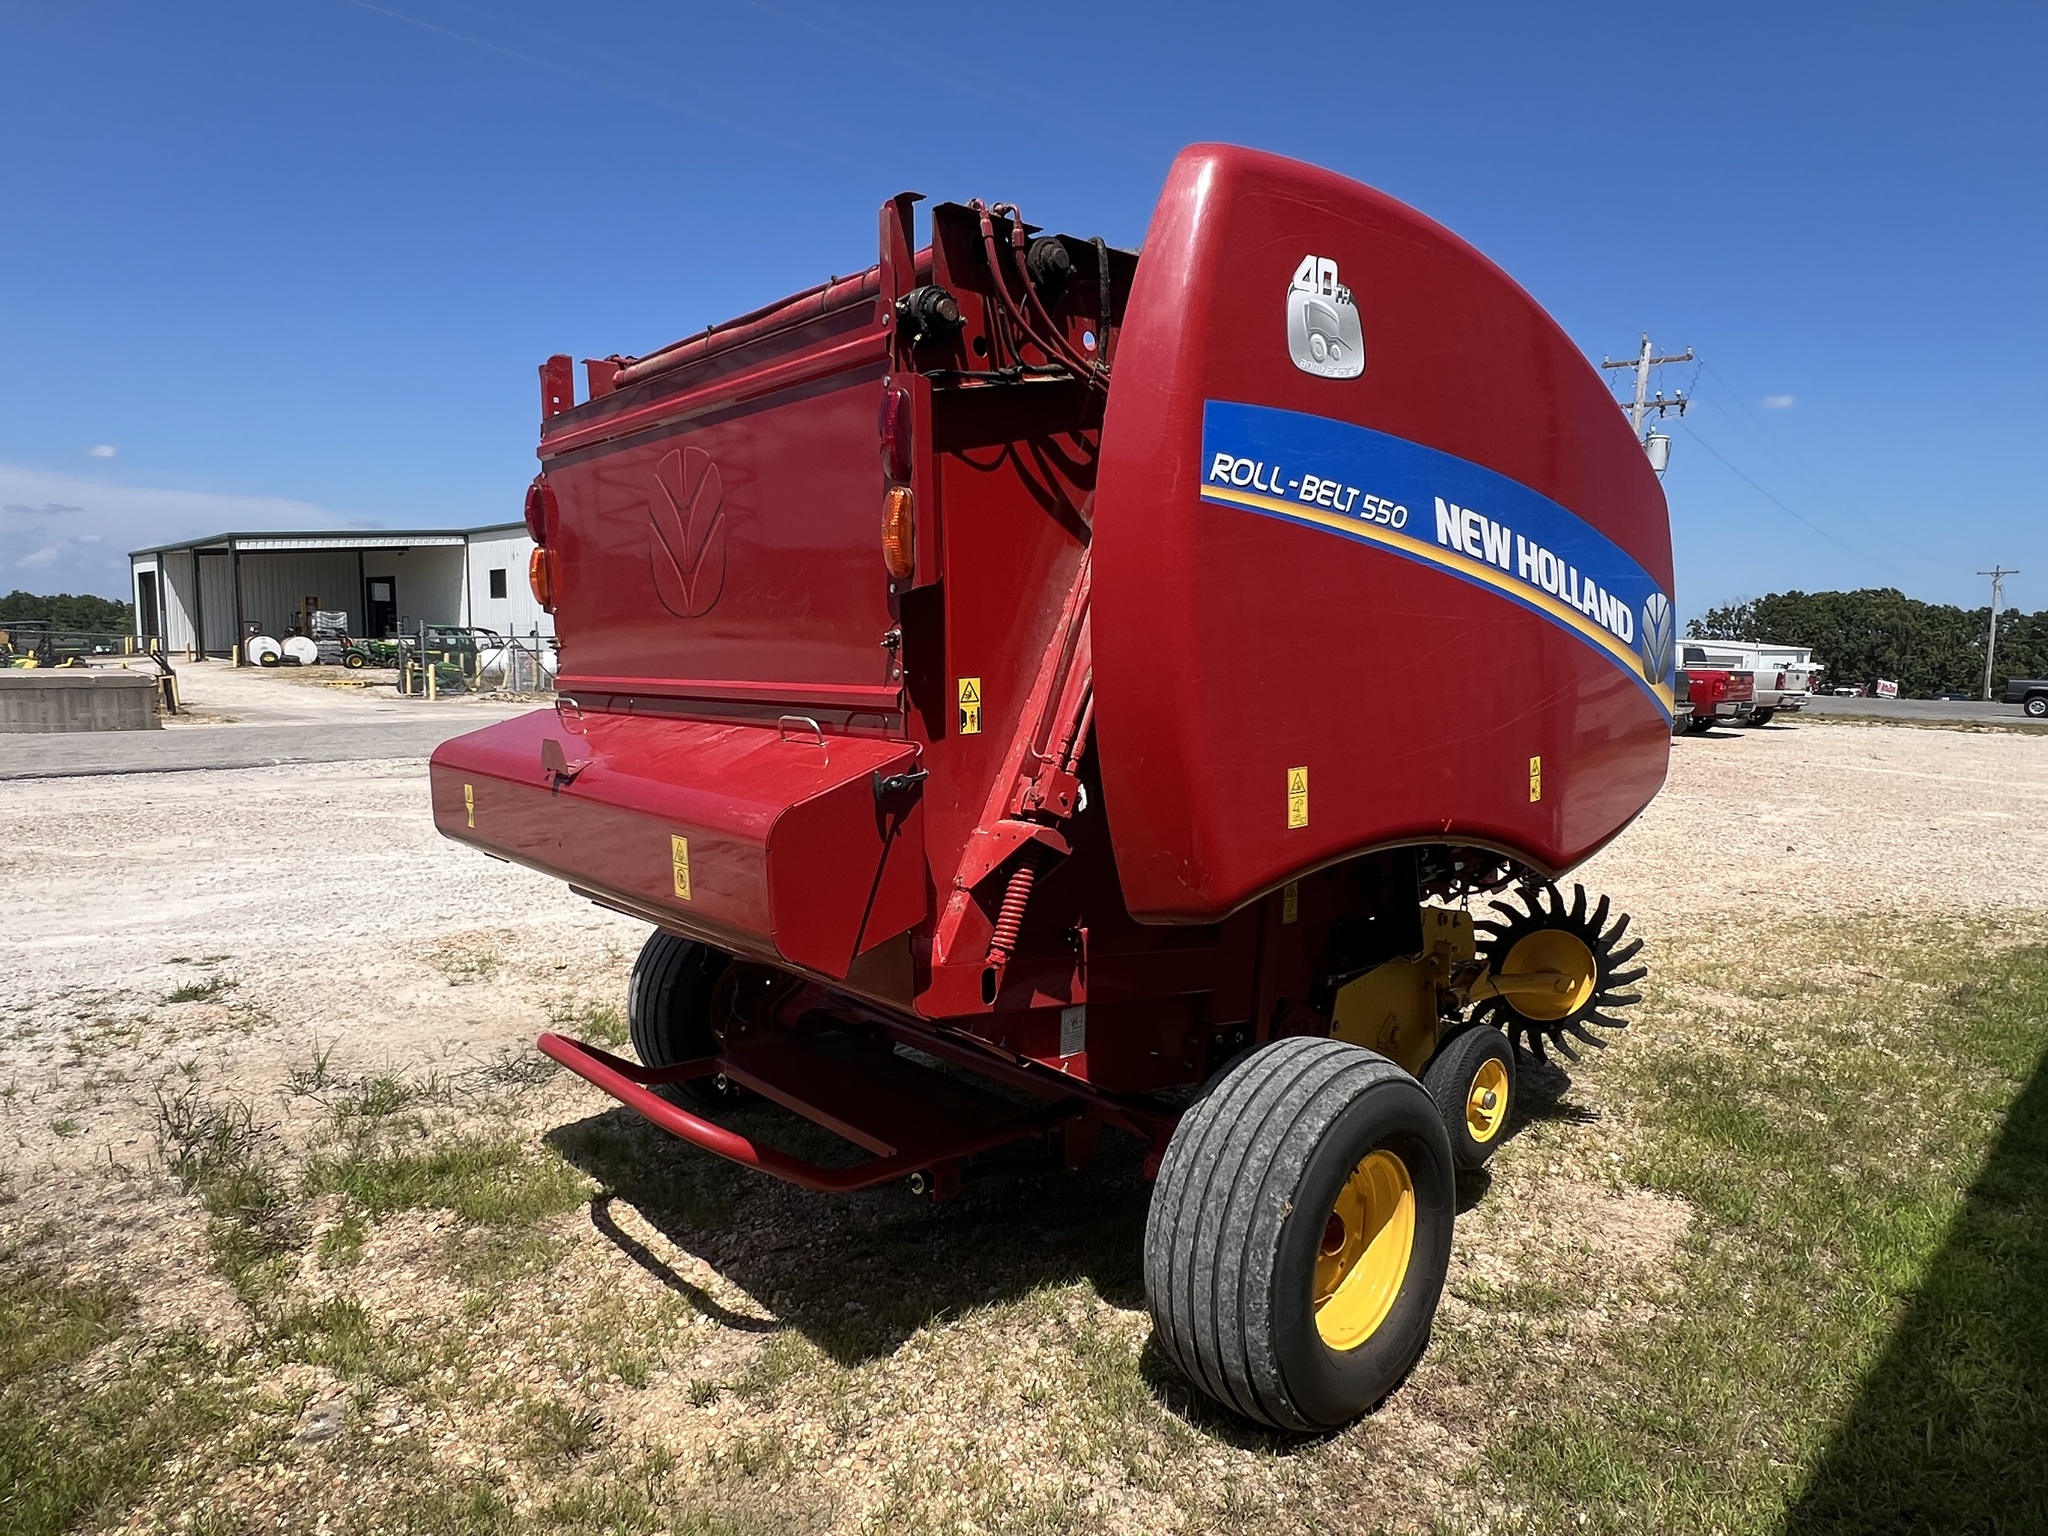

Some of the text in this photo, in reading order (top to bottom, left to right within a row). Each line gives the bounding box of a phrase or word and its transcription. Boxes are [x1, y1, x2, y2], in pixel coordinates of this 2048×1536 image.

[1209, 452, 1409, 529] ROLL-BELT 550
[1434, 496, 1634, 644] NEW HOLLAND
